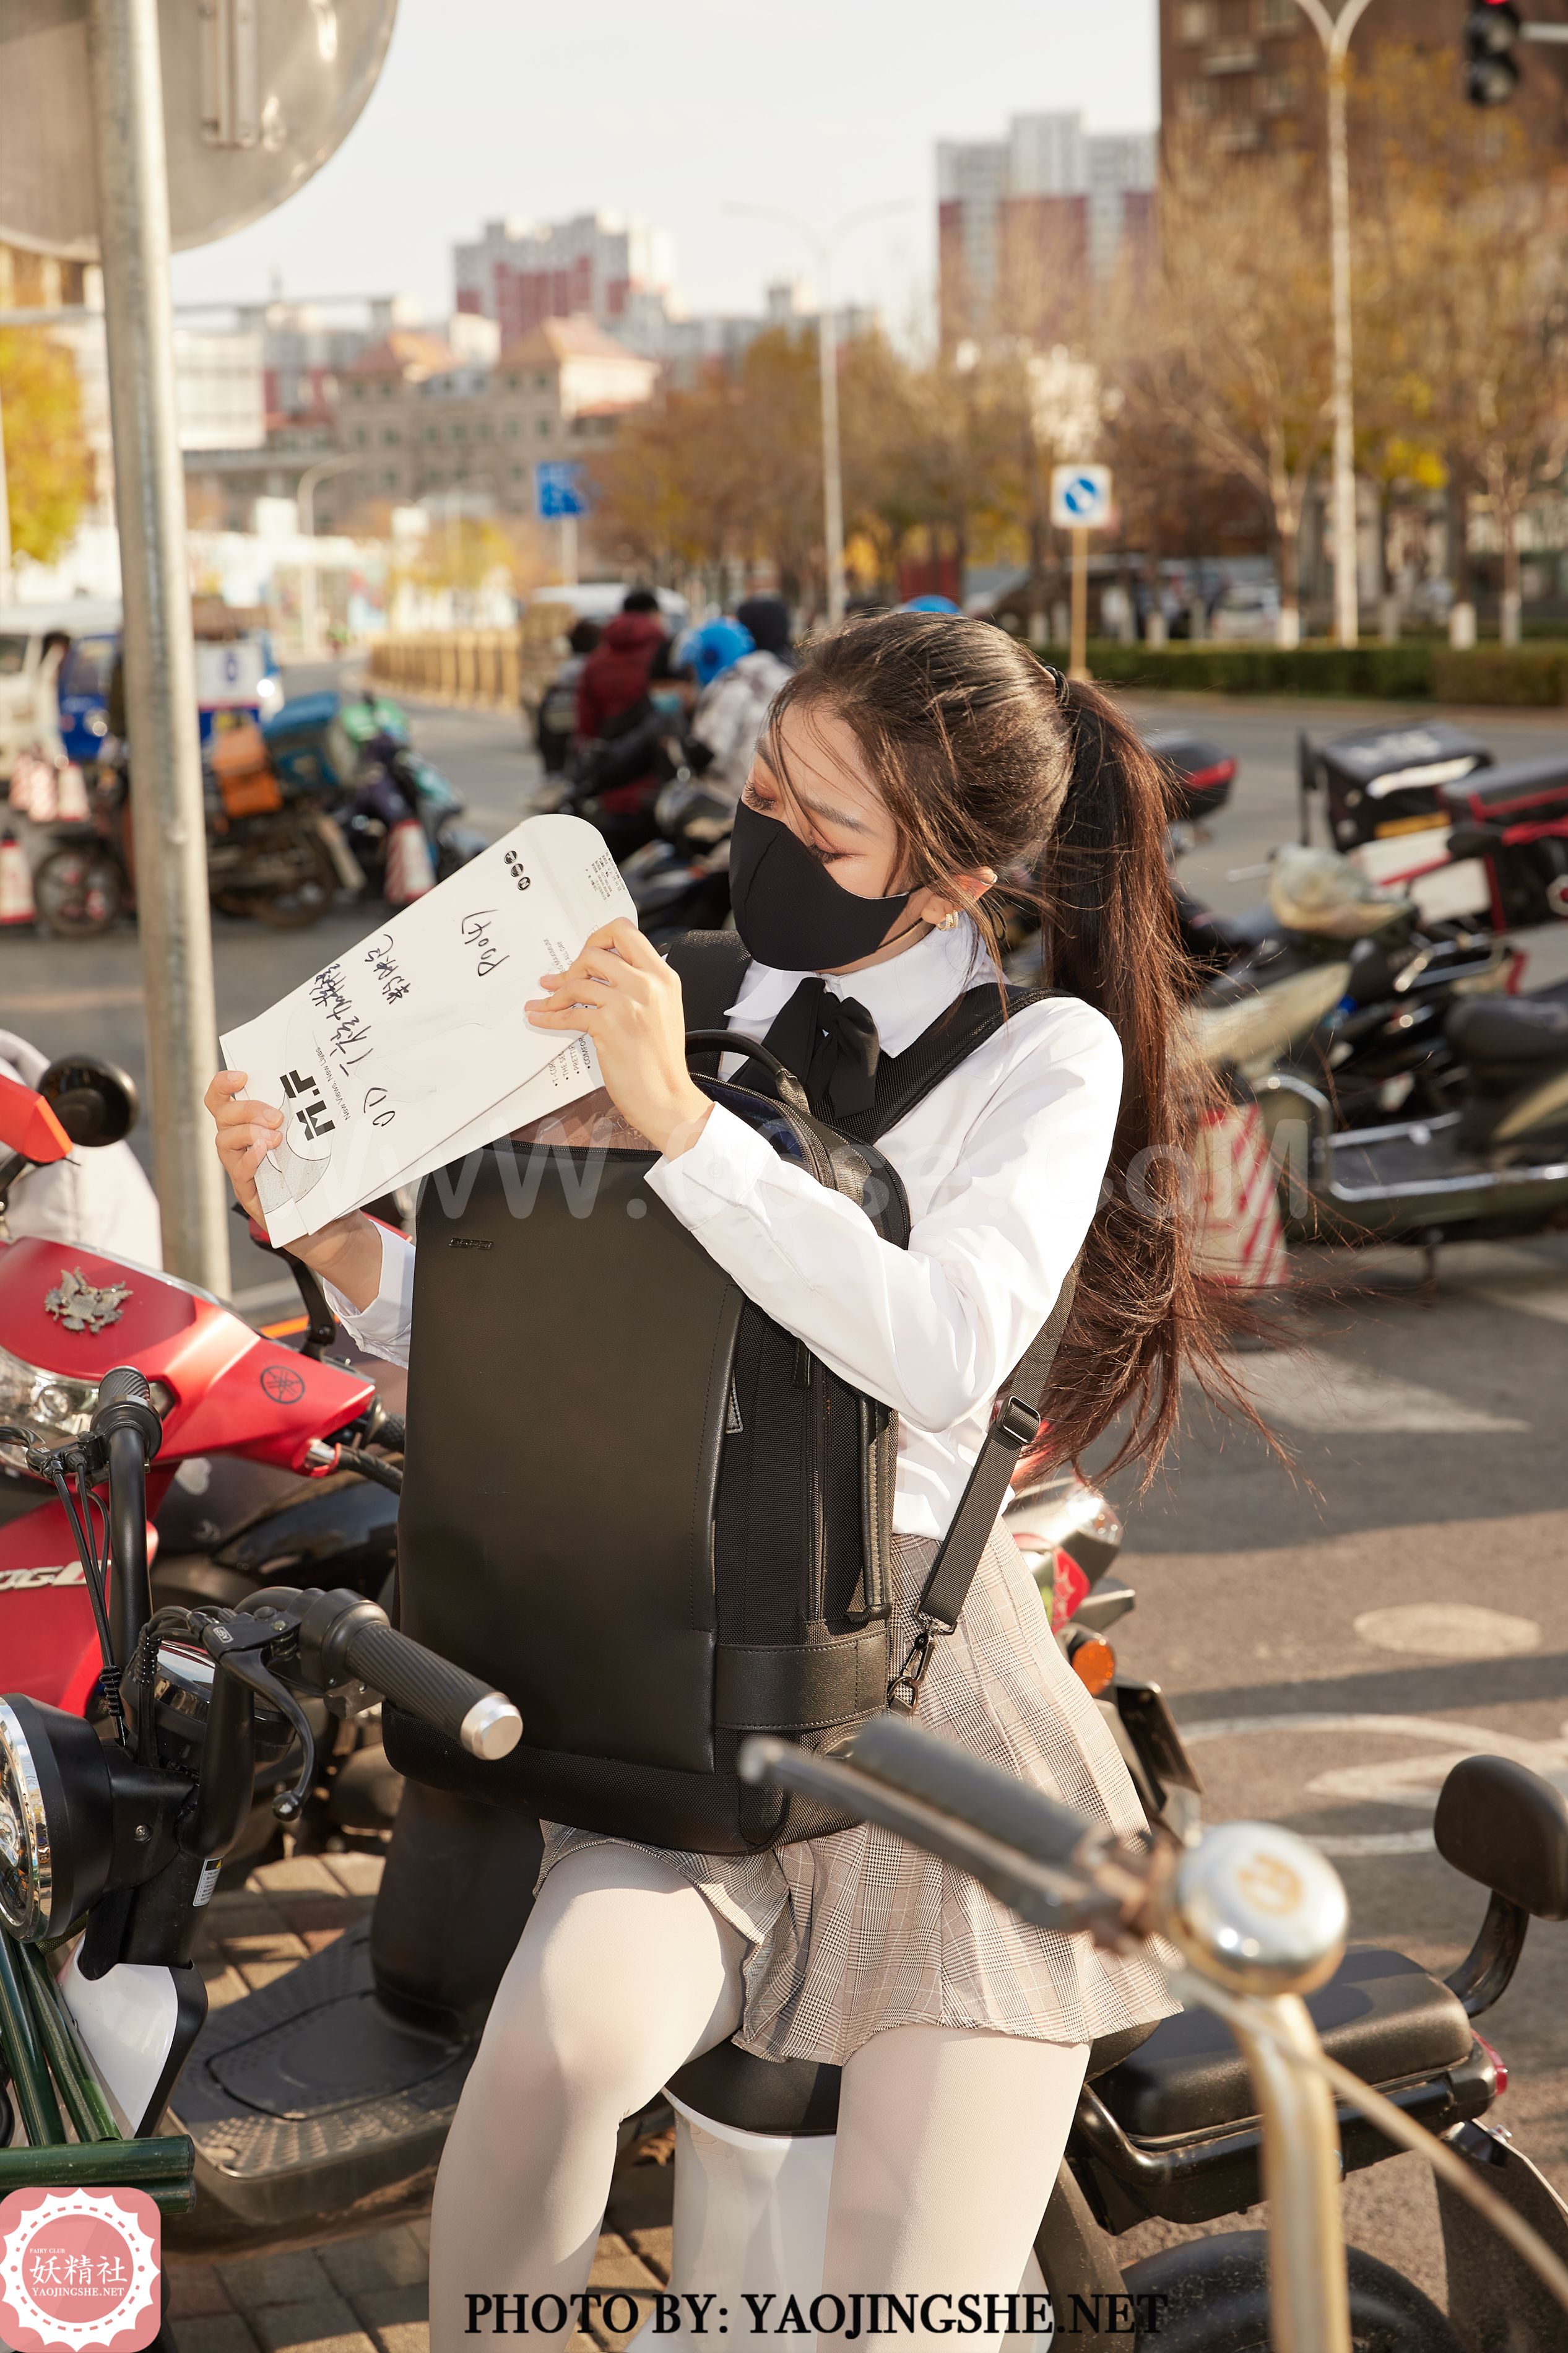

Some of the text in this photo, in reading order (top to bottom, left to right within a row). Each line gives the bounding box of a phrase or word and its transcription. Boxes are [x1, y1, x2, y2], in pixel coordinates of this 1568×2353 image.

[316, 1047, 351, 1121] New Views, New Lives
[561, 1063, 569, 1077] THE
